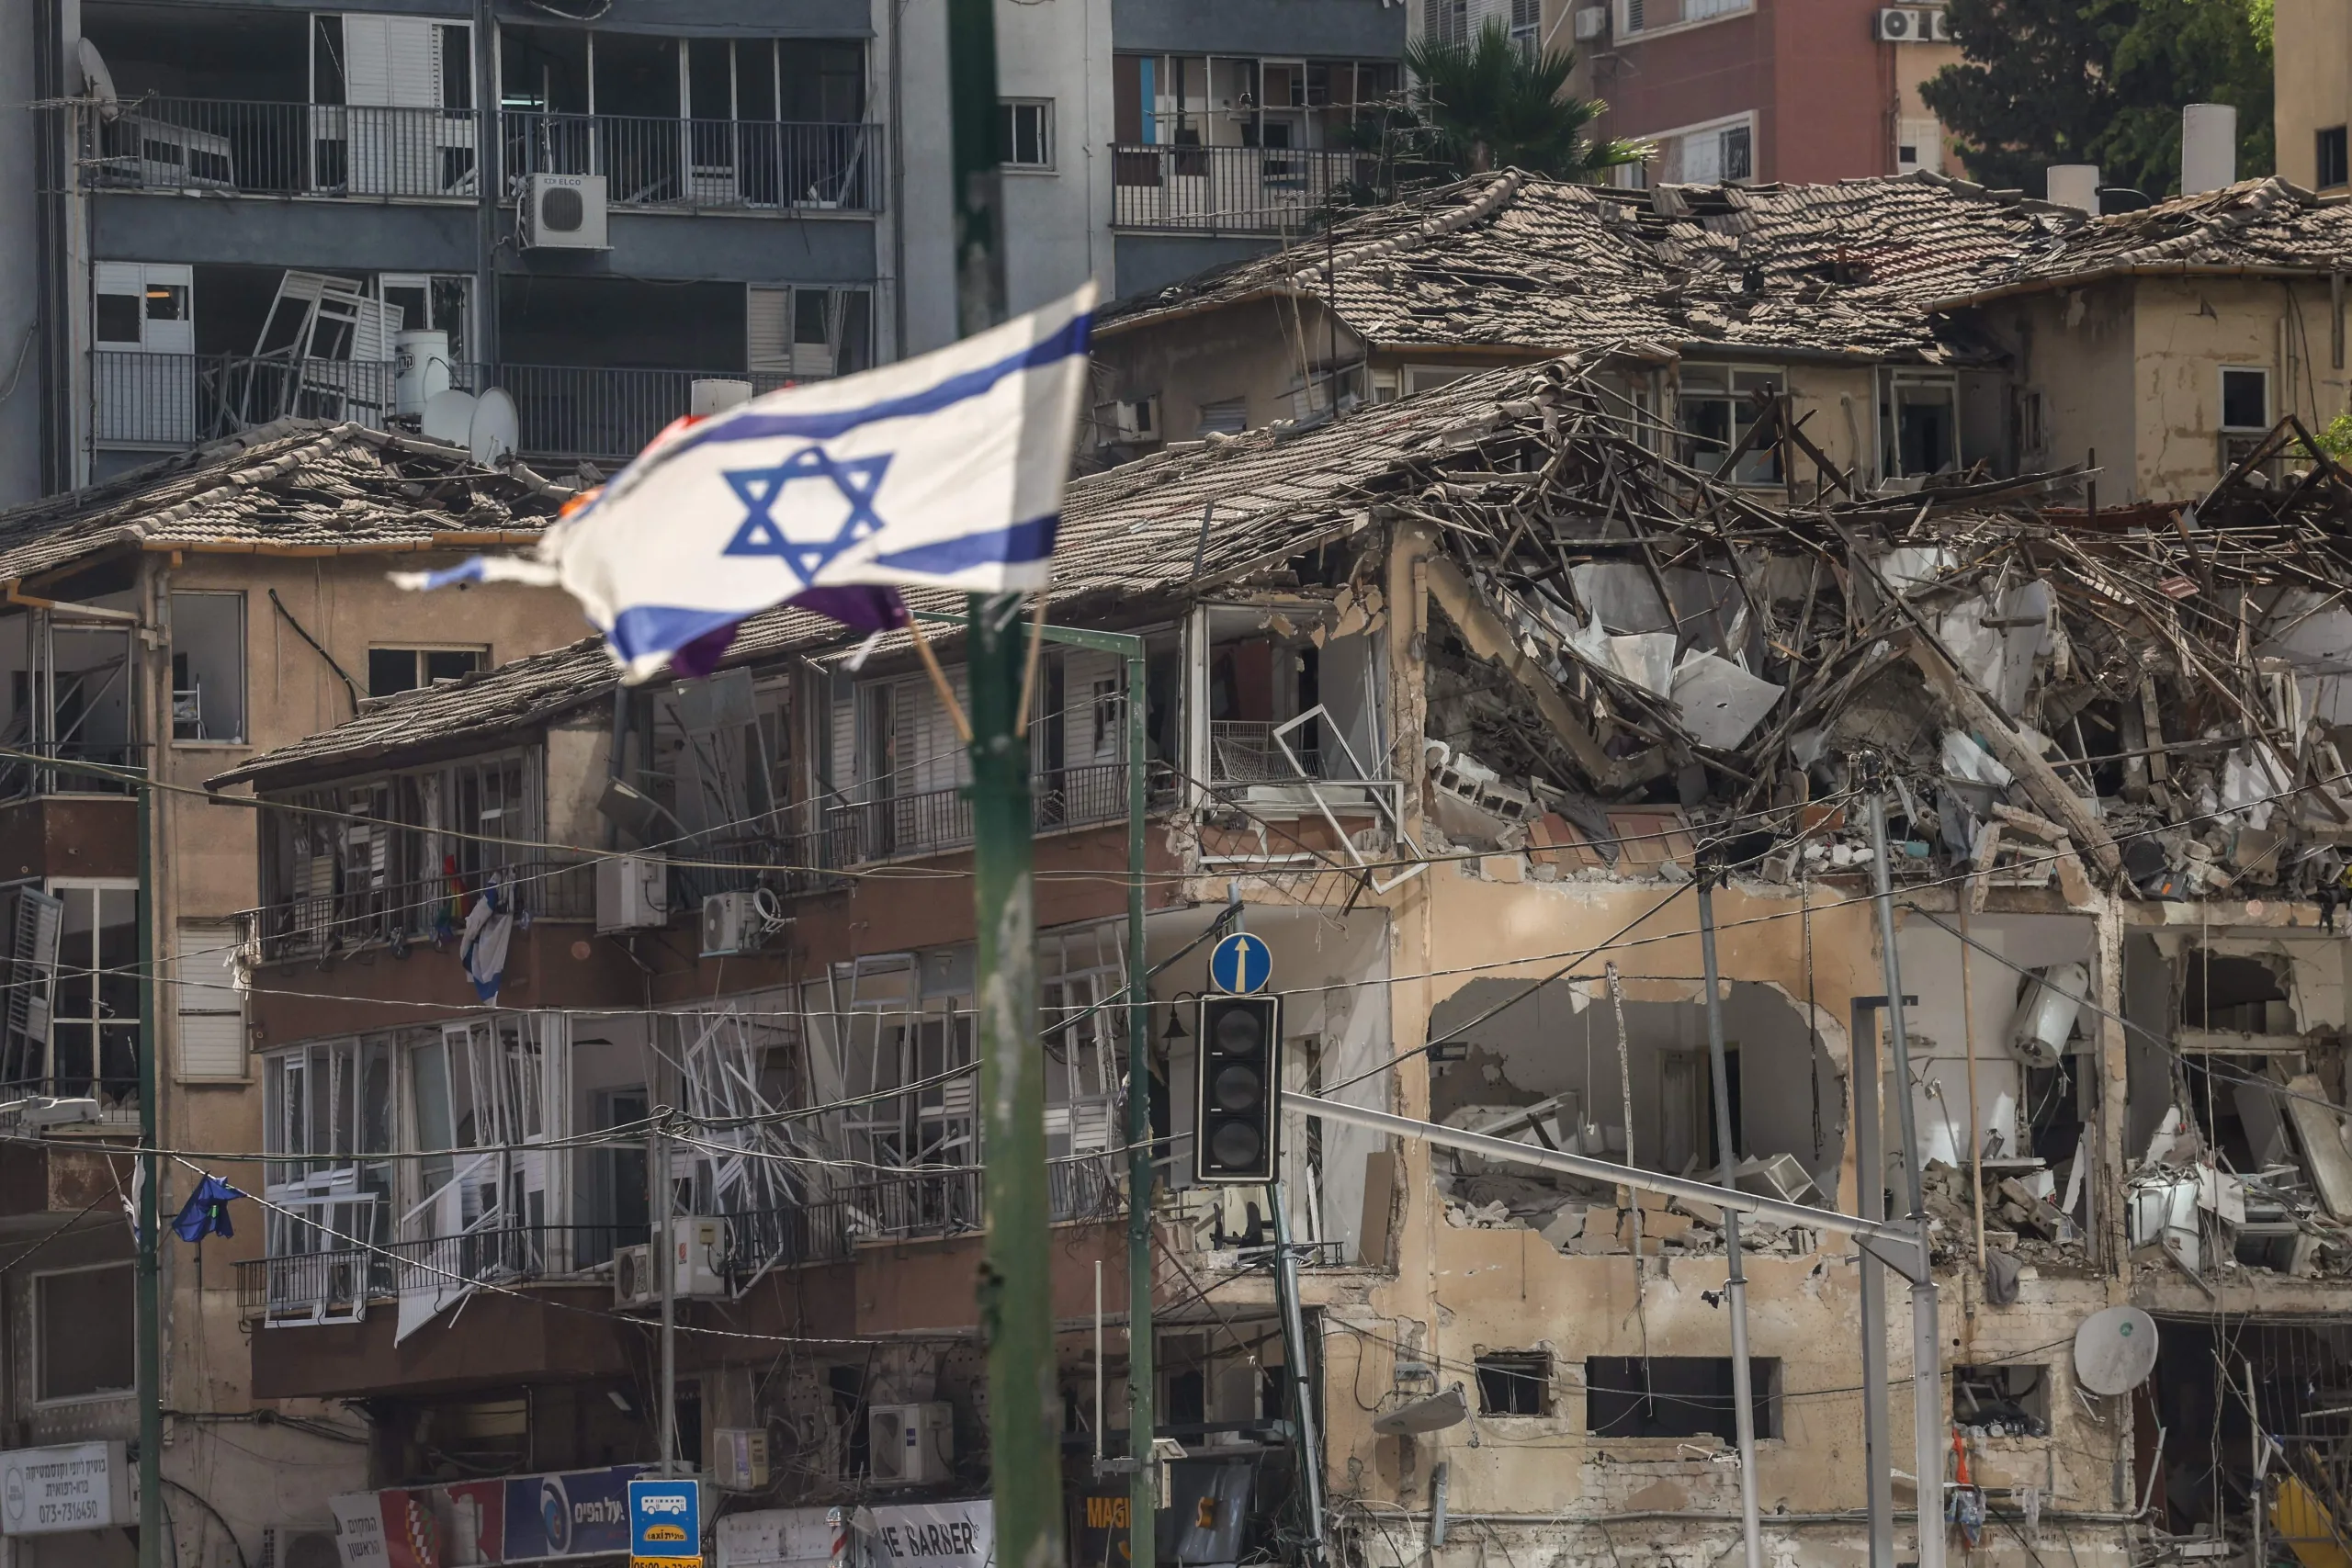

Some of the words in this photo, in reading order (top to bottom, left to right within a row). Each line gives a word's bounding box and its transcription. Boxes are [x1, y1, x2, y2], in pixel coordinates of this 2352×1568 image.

[26, 1462, 68, 1483] וקוסמטיקה
[85, 1458, 107, 1477] בוטיק
[39, 1500, 98, 1524] 073-7316450
[574, 1501, 605, 1523] הפיס
[1086, 1496, 1131, 1529] MAGI
[347, 1517, 378, 1538] המקום
[648, 1529, 663, 1540] taxi
[347, 1540, 381, 1562] הראשון
[882, 1526, 905, 1558] HE
[905, 1522, 977, 1557] BARBER
